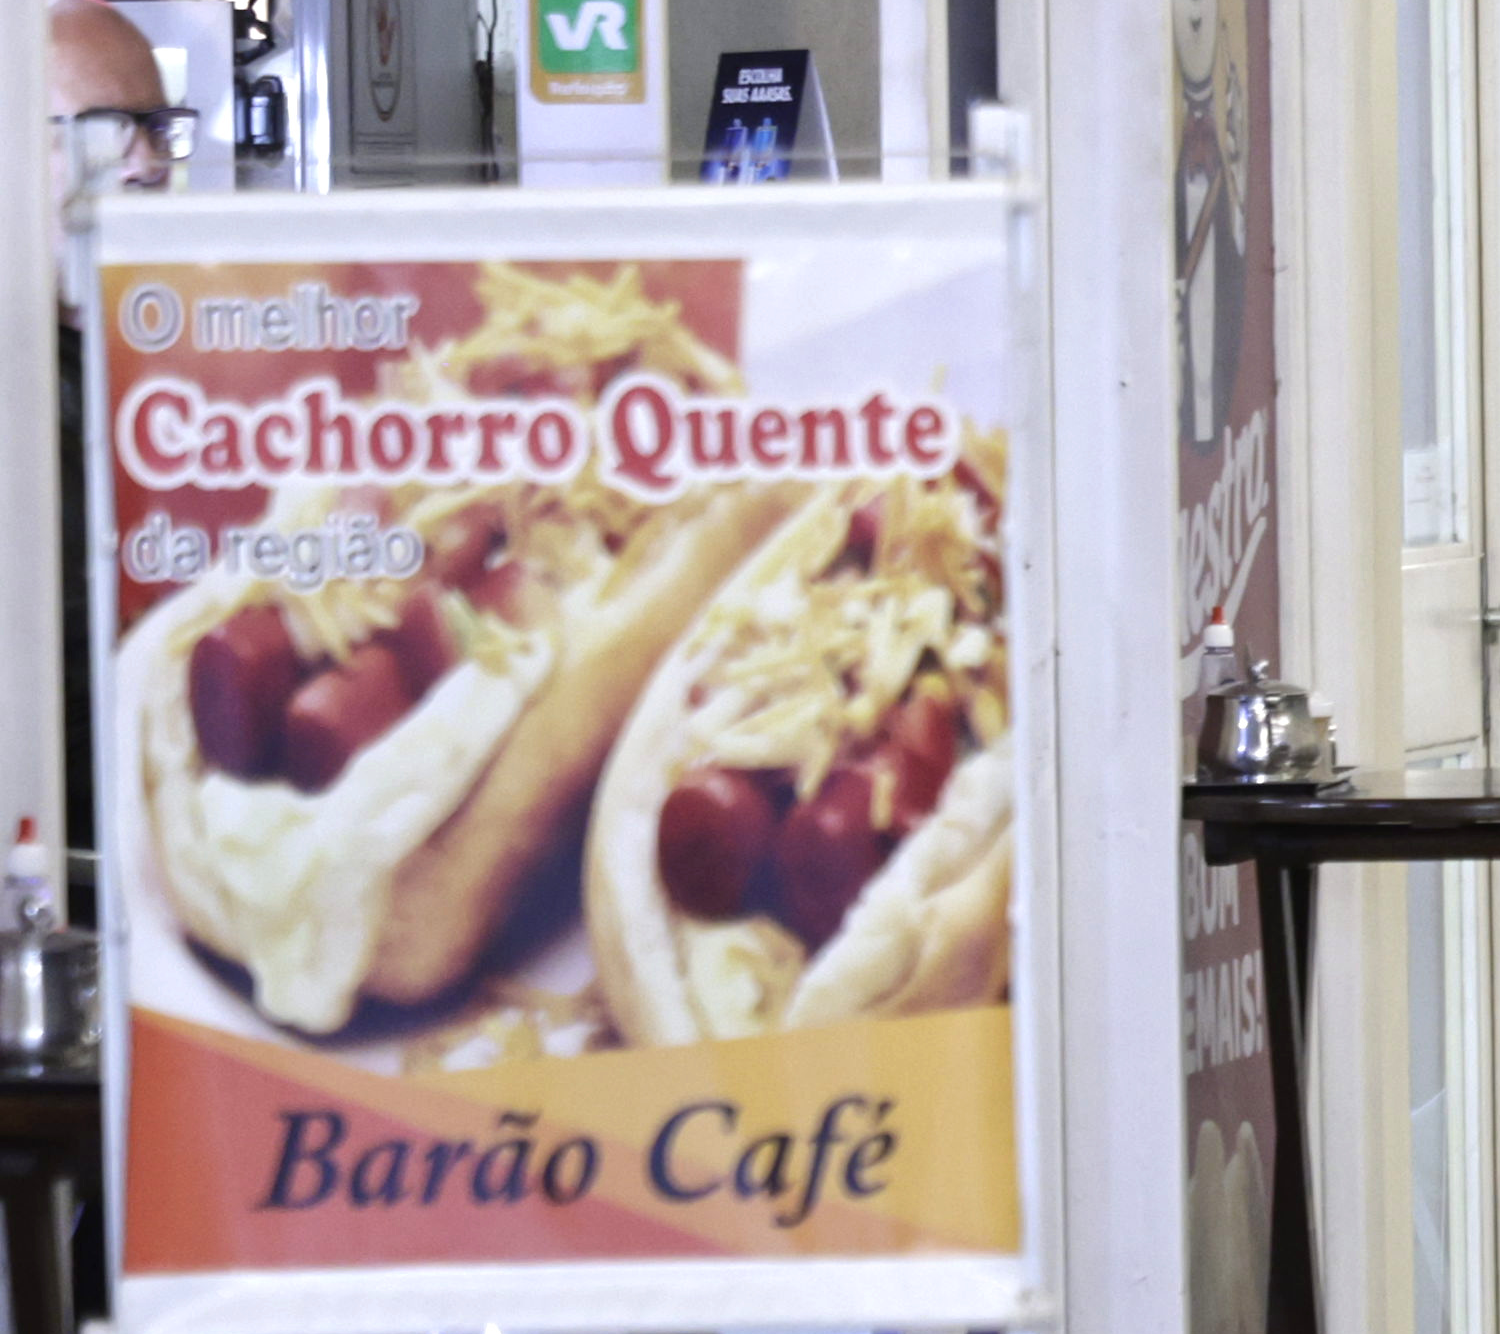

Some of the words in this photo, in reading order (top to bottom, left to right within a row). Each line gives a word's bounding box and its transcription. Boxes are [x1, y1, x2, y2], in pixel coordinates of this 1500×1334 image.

[122, 284, 184, 351] O
[200, 280, 418, 352] melhor
[128, 379, 580, 479] Cachorro
[610, 382, 952, 492] Quente
[129, 517, 218, 581] da
[228, 517, 422, 588] região
[256, 1107, 599, 1213] Barão
[646, 1095, 898, 1228] Café
